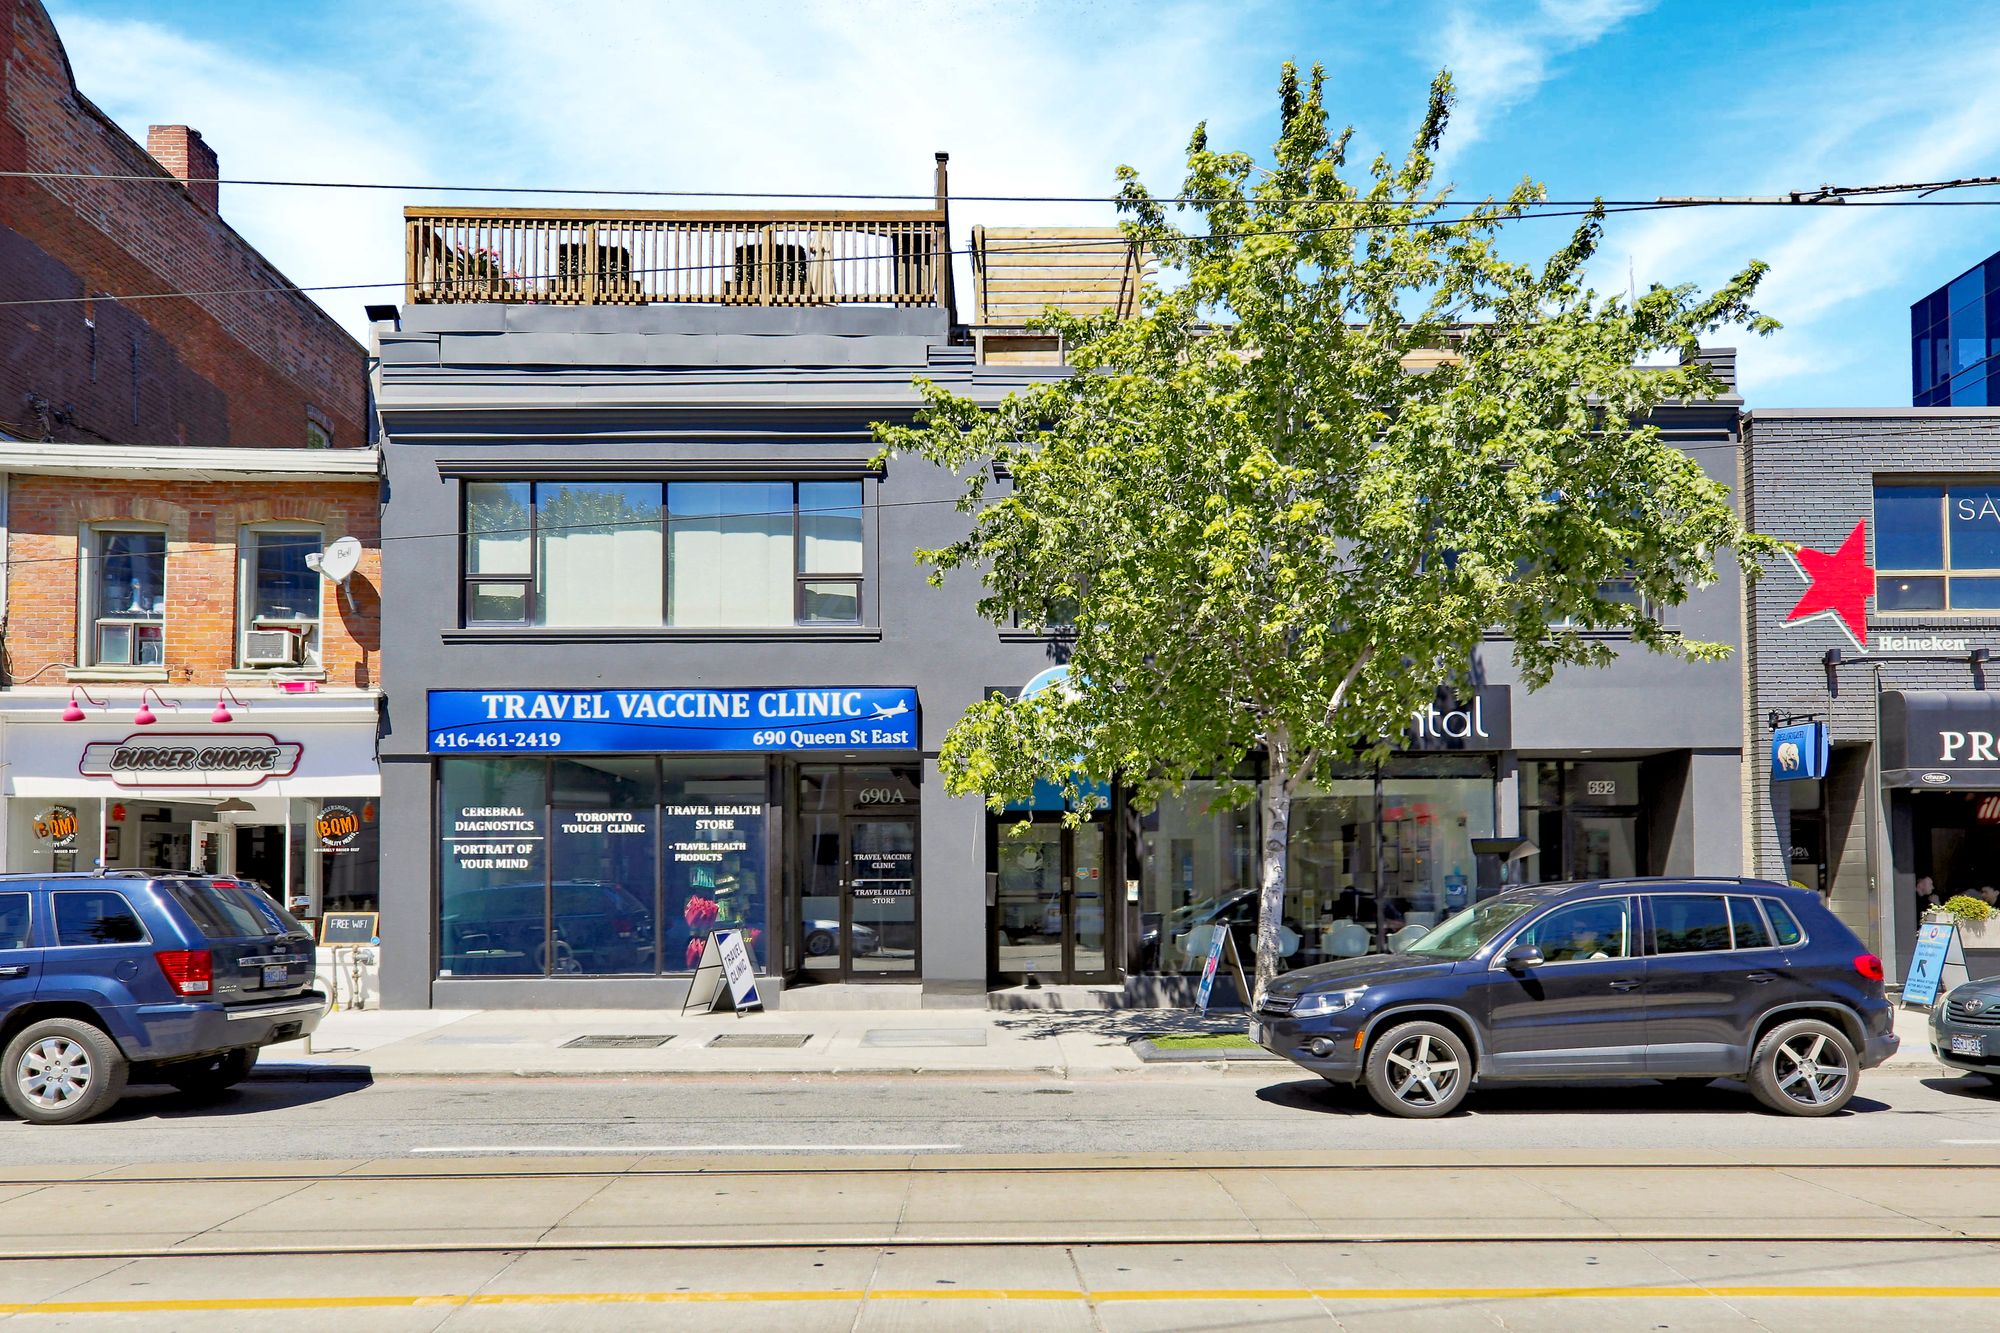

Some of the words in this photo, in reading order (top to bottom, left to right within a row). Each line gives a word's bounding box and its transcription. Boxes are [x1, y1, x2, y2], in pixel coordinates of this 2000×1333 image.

[1958, 493, 2000, 522] SA
[337, 547, 352, 559] Bell
[1878, 636, 1966, 651] Heineken
[481, 694, 610, 719] TRAVEL
[617, 693, 750, 718] VACCINE
[758, 692, 861, 718] CLINIC
[434, 732, 561, 747] 416-461-2419
[752, 731, 786, 745] 690
[790, 730, 846, 748] Queen
[850, 729, 868, 744] St
[871, 729, 909, 744] East
[1938, 731, 2000, 761] PR
[111, 747, 197, 770] BURGER
[197, 747, 280, 770] SHOPPE
[1590, 782, 1614, 793] 692
[859, 788, 906, 804] 690A
[462, 807, 524, 817] CEREBRAL
[666, 805, 712, 815] TRAVEL
[714, 805, 761, 815] HEALTH
[575, 812, 632, 822] TORONTO
[320, 816, 353, 837] BQM
[455, 821, 534, 832] DIAGNOSTICS
[561, 824, 602, 834] TOUCH
[607, 824, 646, 833] CLINIC
[695, 820, 735, 830] STORE
[453, 845, 515, 855] PORTRAIT
[516, 844, 534, 854] OF
[674, 843, 709, 851] TRAVEL
[710, 842, 747, 850] HEALTH
[674, 853, 723, 862] PRODUCTS
[460, 860, 494, 869] YOUR
[495, 859, 529, 869] MIND
[854, 888, 882, 896] TRAVEL
[883, 888, 911, 896] HEALTH
[330, 919, 350, 929] FREE
[351, 919, 368, 929] WIFI
[724, 942, 743, 968] TRAVEL
[730, 958, 748, 985] CLINIC
